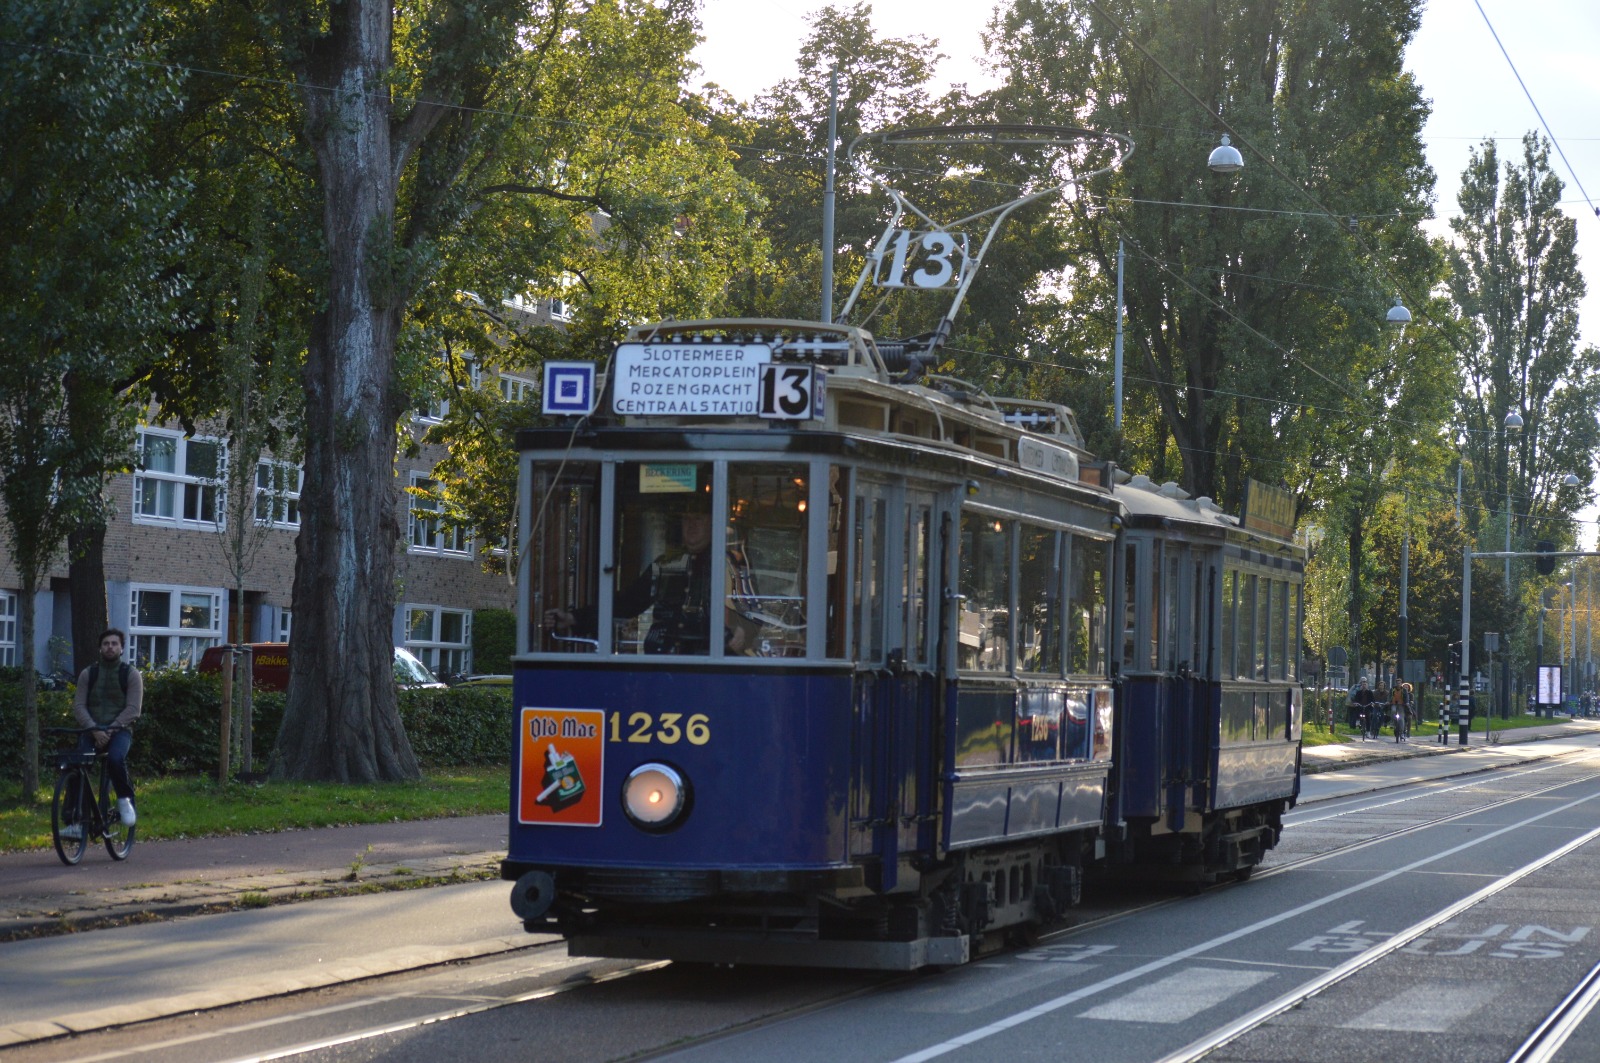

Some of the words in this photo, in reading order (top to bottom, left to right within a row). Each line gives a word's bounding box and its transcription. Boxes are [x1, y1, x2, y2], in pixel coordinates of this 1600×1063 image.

[880, 230, 954, 288] 13
[643, 349, 745, 361] SLOTERMEER
[629, 365, 756, 378] MERCATORPLEIN
[631, 382, 752, 395] ROZENGRACHT
[761, 367, 809, 416] 13
[616, 399, 759, 412] CENTRAALSTATIO
[530, 717, 558, 741] Old
[561, 717, 596, 738] Mac
[609, 711, 710, 745] 1236
[1287, 936, 1568, 959] BUS
